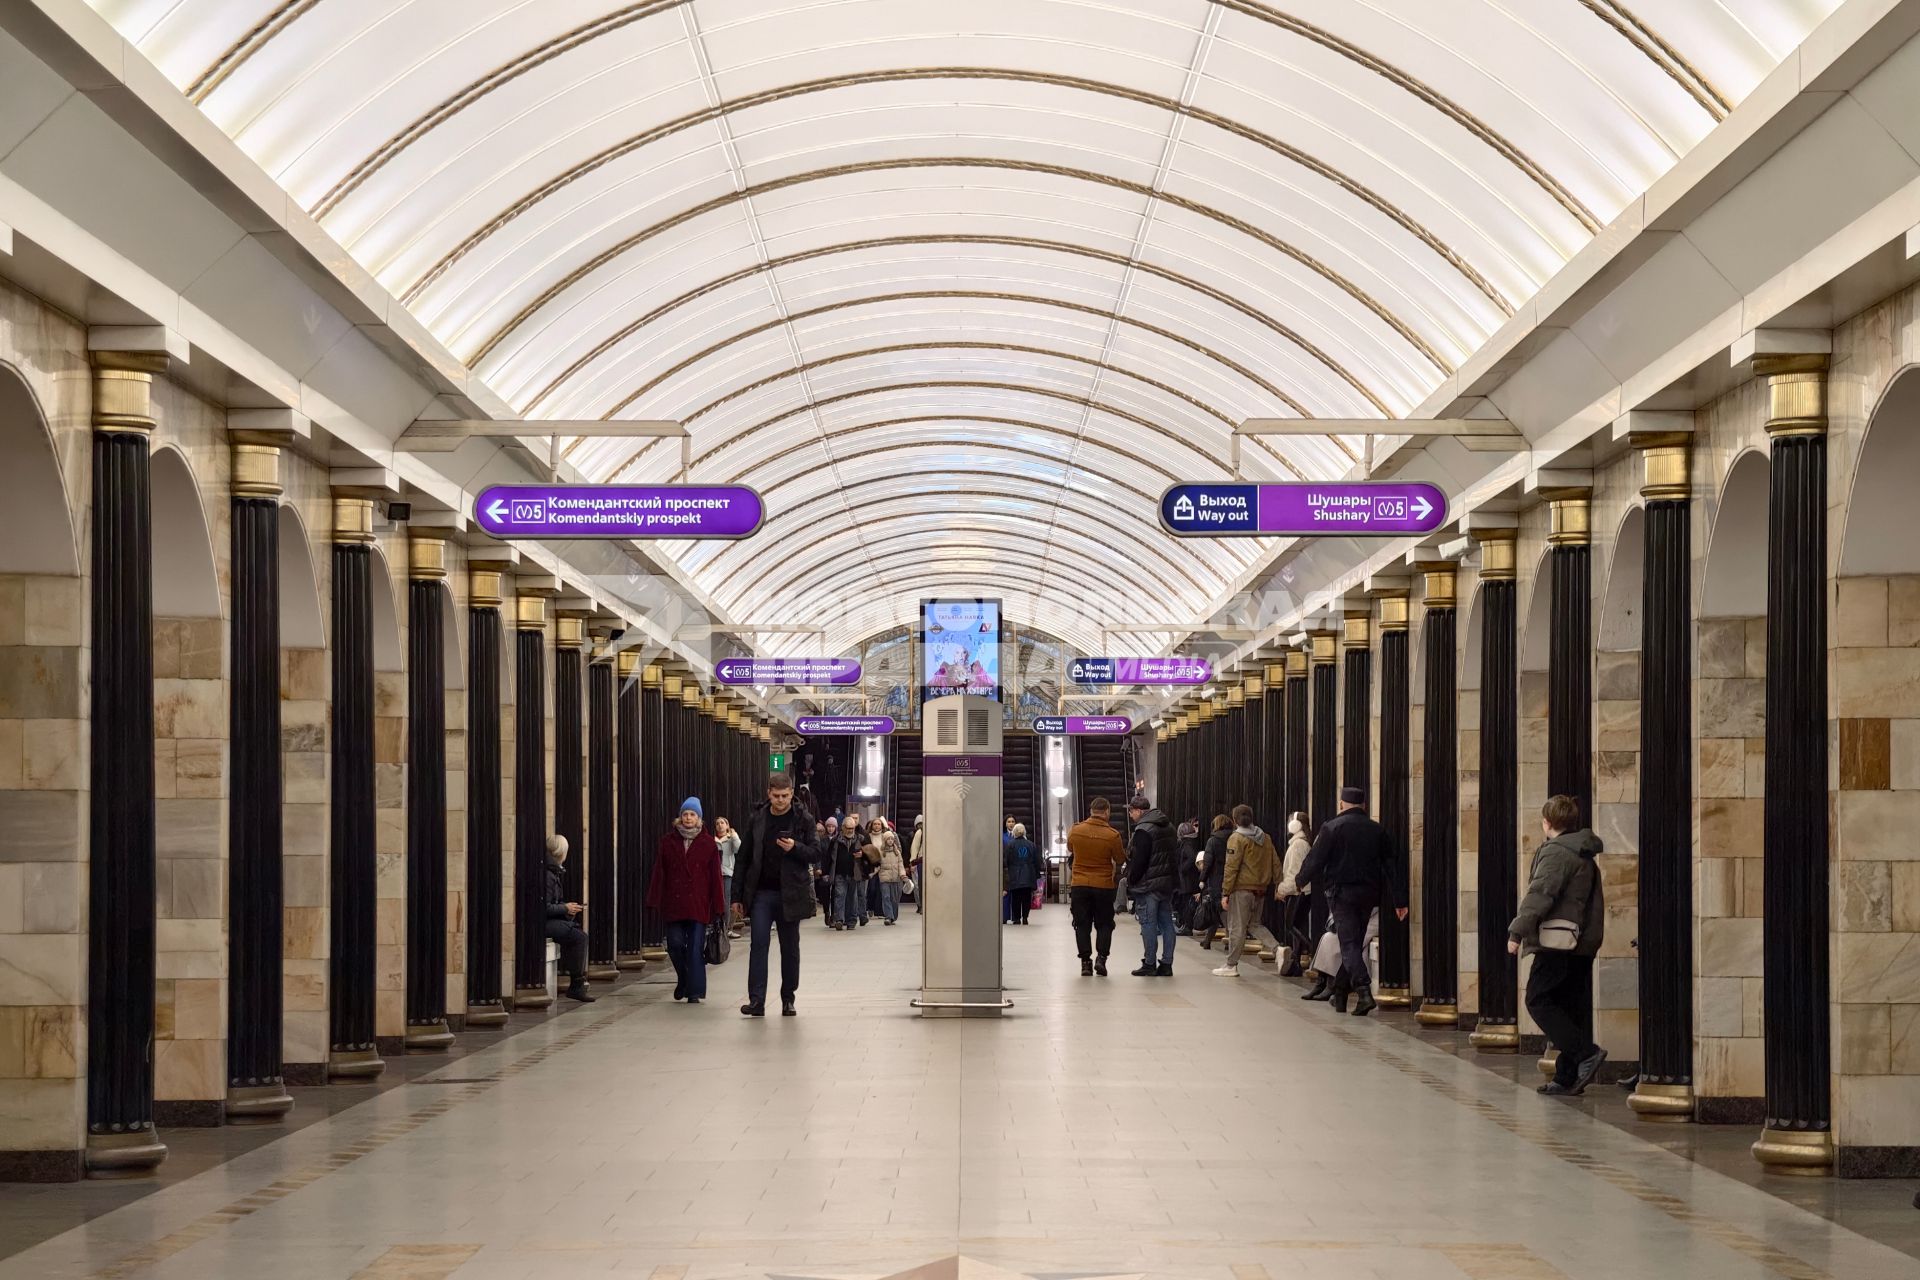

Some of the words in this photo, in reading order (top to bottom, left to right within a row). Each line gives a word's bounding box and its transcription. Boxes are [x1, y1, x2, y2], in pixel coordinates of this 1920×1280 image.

[548, 496, 663, 511] Комендантский
[664, 499, 730, 511] проспект
[1200, 494, 1247, 508] Выход
[1307, 494, 1371, 509] Шушары
[548, 511, 645, 526] Komendantskiy
[646, 511, 702, 526] prospekt
[1198, 510, 1225, 524] Way
[1228, 510, 1249, 521] out
[1313, 509, 1371, 523] Shushary
[752, 663, 812, 672] Комендантский
[813, 664, 846, 672] проспект
[1085, 664, 1110, 672] Выход
[1140, 664, 1174, 672] Шушары
[752, 672, 801, 680] Komendantskiy
[802, 672, 831, 680] prospekt
